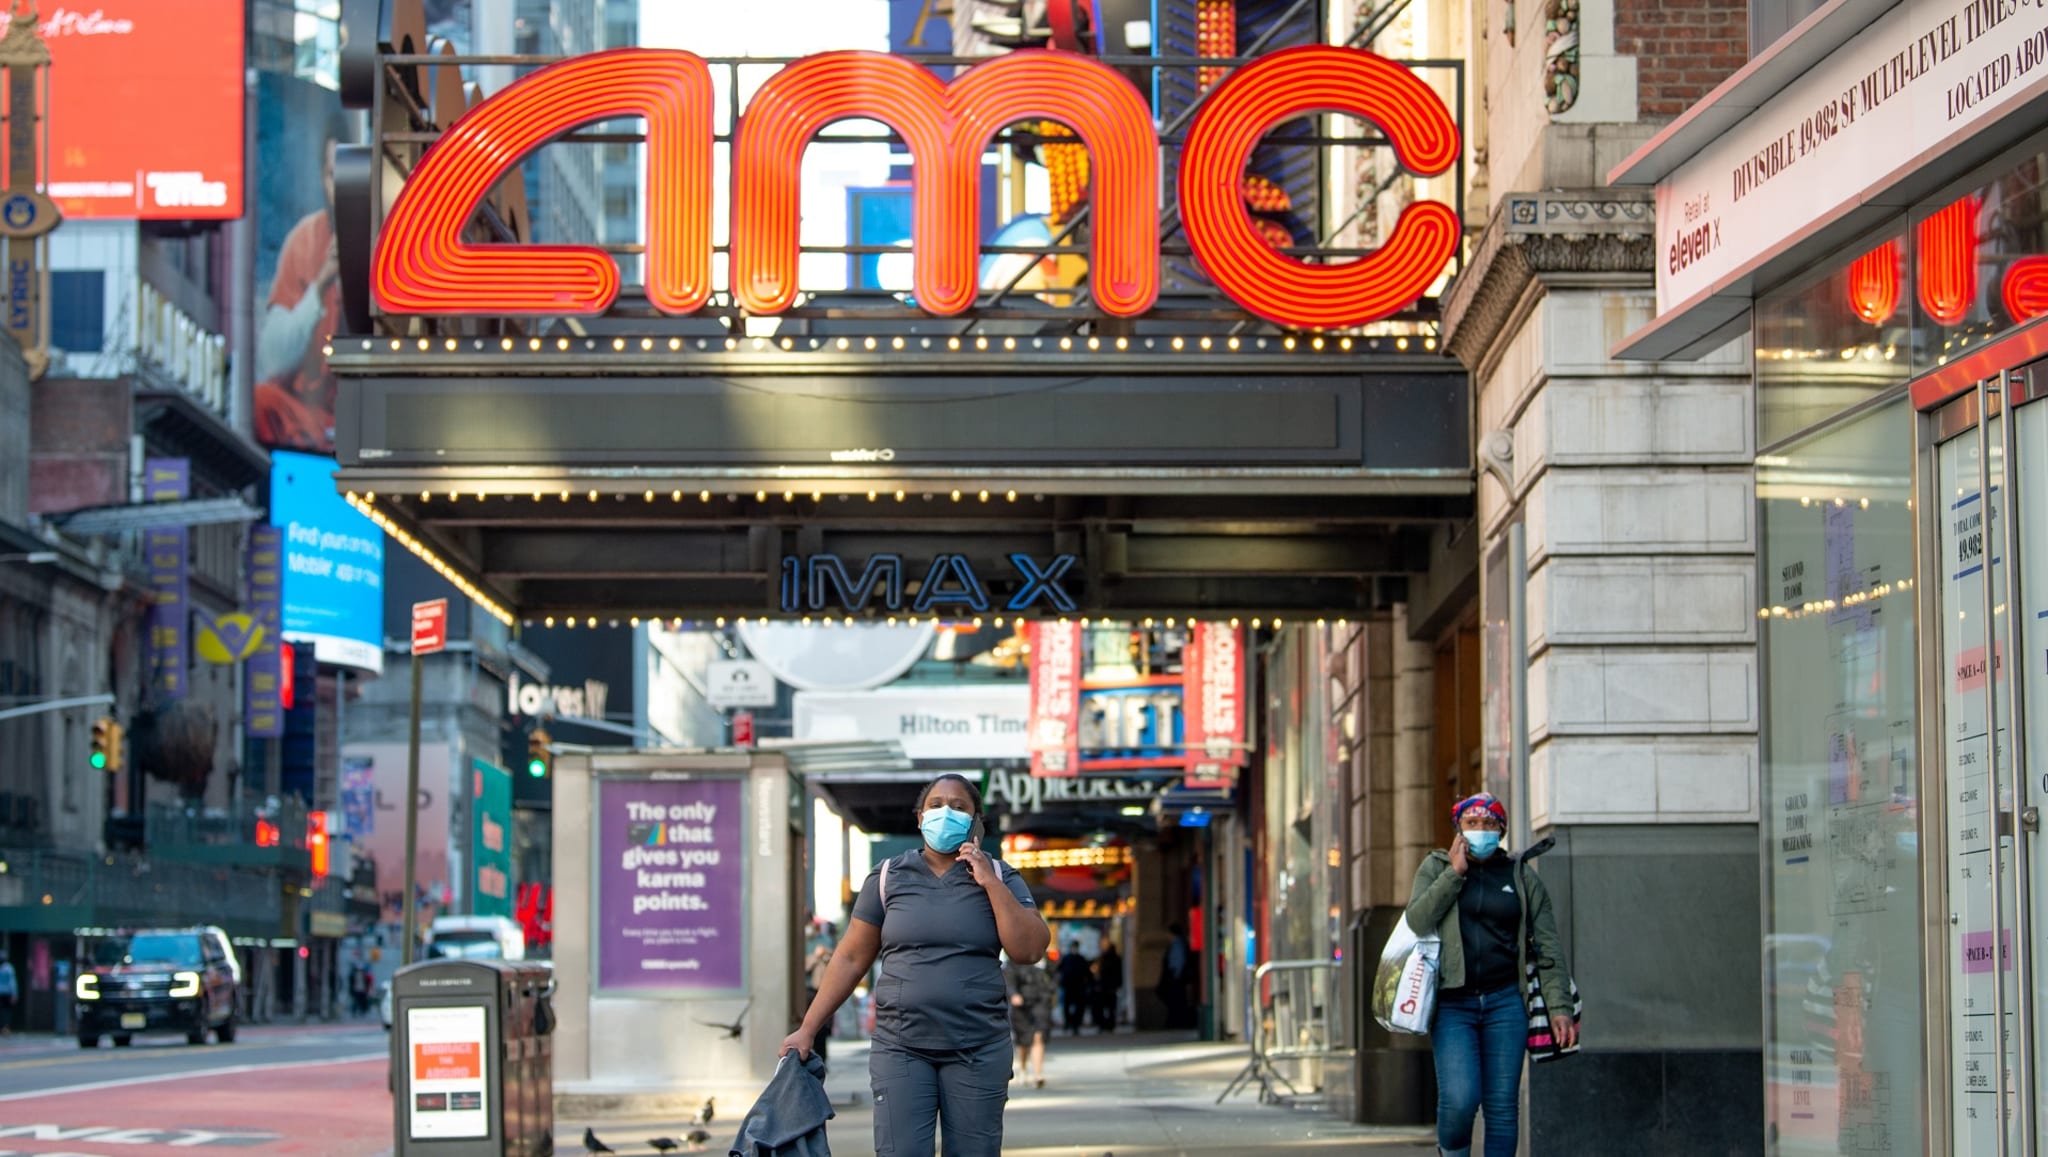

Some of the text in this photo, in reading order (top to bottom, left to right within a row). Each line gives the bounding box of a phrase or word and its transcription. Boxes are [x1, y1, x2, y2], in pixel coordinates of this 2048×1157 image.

[1733, 0, 2017, 203] DIVISIBLE 49,982 SF MULTI-LEVEL TIMES
[1947, 53, 2011, 121] LOCATED
[369, 45, 1461, 328] amc
[1685, 190, 1711, 224] Retail at
[1669, 222, 1711, 276] eleven
[10, 260, 30, 329] LYRIC
[781, 553, 1077, 612] IMAX
[900, 714, 970, 735] Hilton
[625, 800, 716, 824] The only
[668, 823, 714, 843] that
[622, 846, 720, 870] gives you
[637, 867, 706, 888] karma
[633, 890, 709, 915] points.
